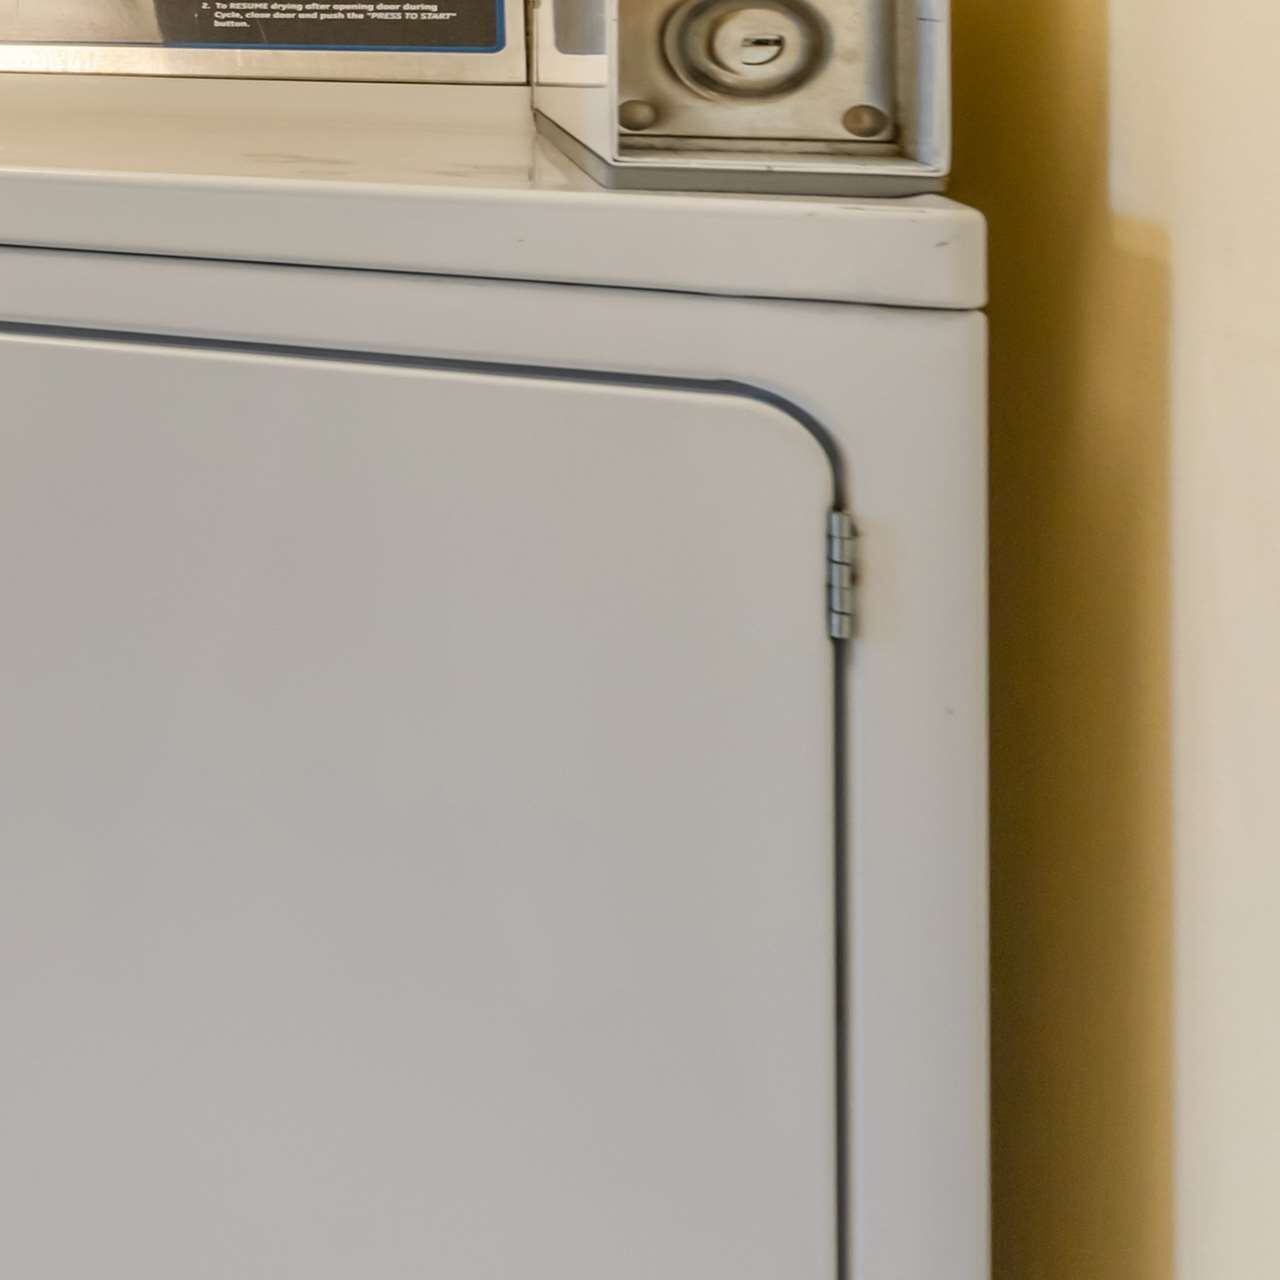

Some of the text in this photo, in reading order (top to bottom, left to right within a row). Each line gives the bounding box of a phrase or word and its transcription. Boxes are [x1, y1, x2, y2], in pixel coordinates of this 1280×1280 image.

[201, 2, 211, 10] 2.
[215, 2, 228, 10] To
[229, 2, 269, 10] RESUME
[270, 2, 304, 12] drying
[332, 3, 374, 12] opening
[376, 2, 401, 10] door
[402, 2, 438, 12] during
[214, 11, 244, 20] Cycle,
[245, 11, 271, 19] close
[272, 11, 297, 19] door
[319, 12, 345, 20] push
[346, 11, 365, 19] the
[366, 12, 402, 20] "PRESS
[404, 12, 418, 20] TO
[420, 12, 457, 20] START"
[213, 19, 251, 28] button.
